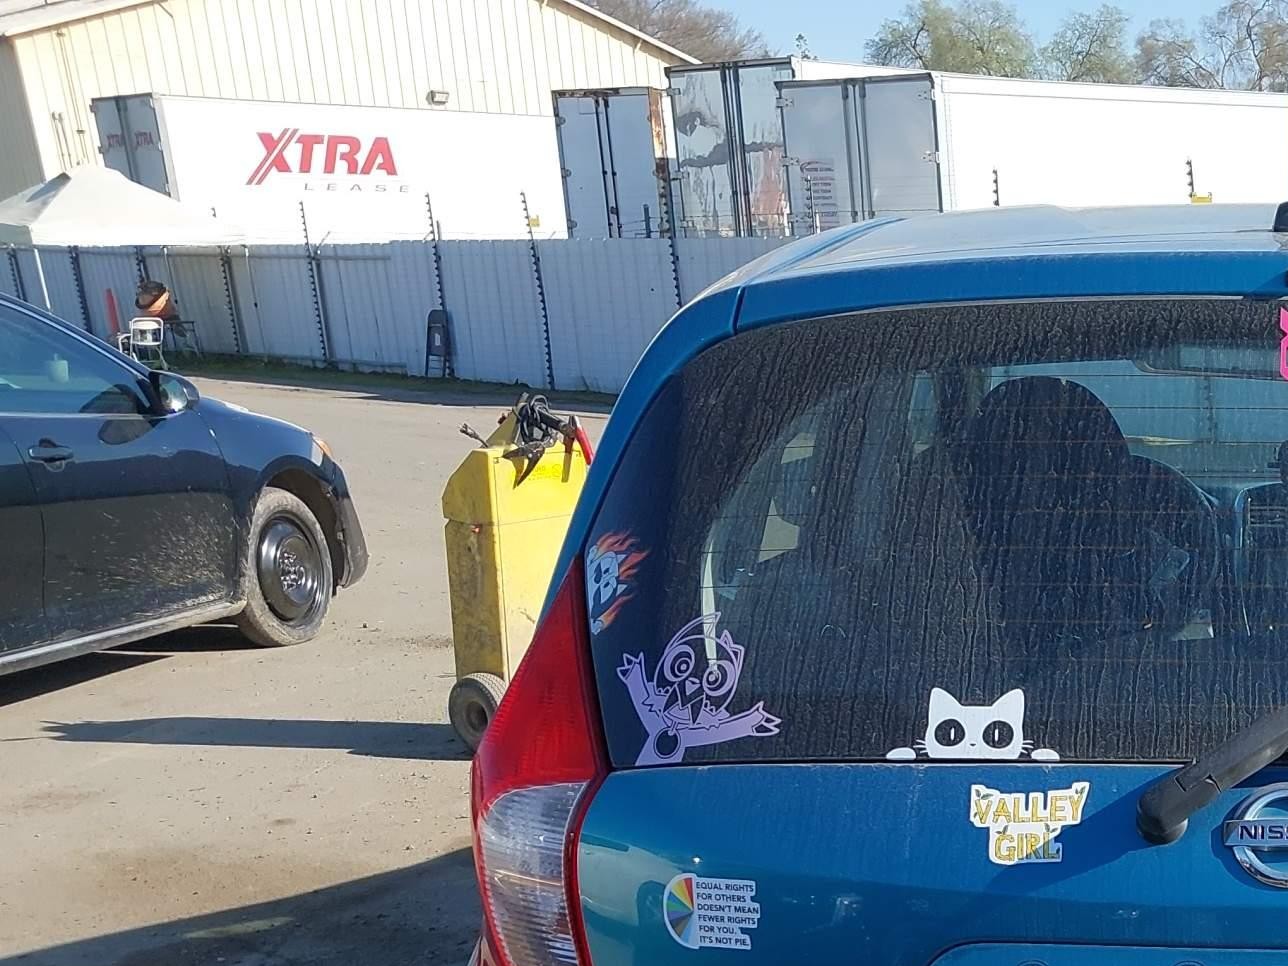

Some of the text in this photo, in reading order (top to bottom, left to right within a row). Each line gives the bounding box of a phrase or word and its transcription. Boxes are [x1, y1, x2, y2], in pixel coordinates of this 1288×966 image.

[246, 128, 398, 185] XTRA
[304, 182, 410, 193] LEASE
[975, 795, 1083, 824] VALLEY
[995, 832, 1061, 861] GIRL
[696, 881, 754, 892] EQUAL RIGHTS
[697, 892, 746, 902] FOR OTHERS
[697, 903, 759, 914] DOESN'T MEAN
[698, 914, 756, 925] FEWER RIGHTS
[699, 925, 715, 933] FOR
[700, 935, 714, 944] IT'S
[716, 936, 732, 945] NOT
